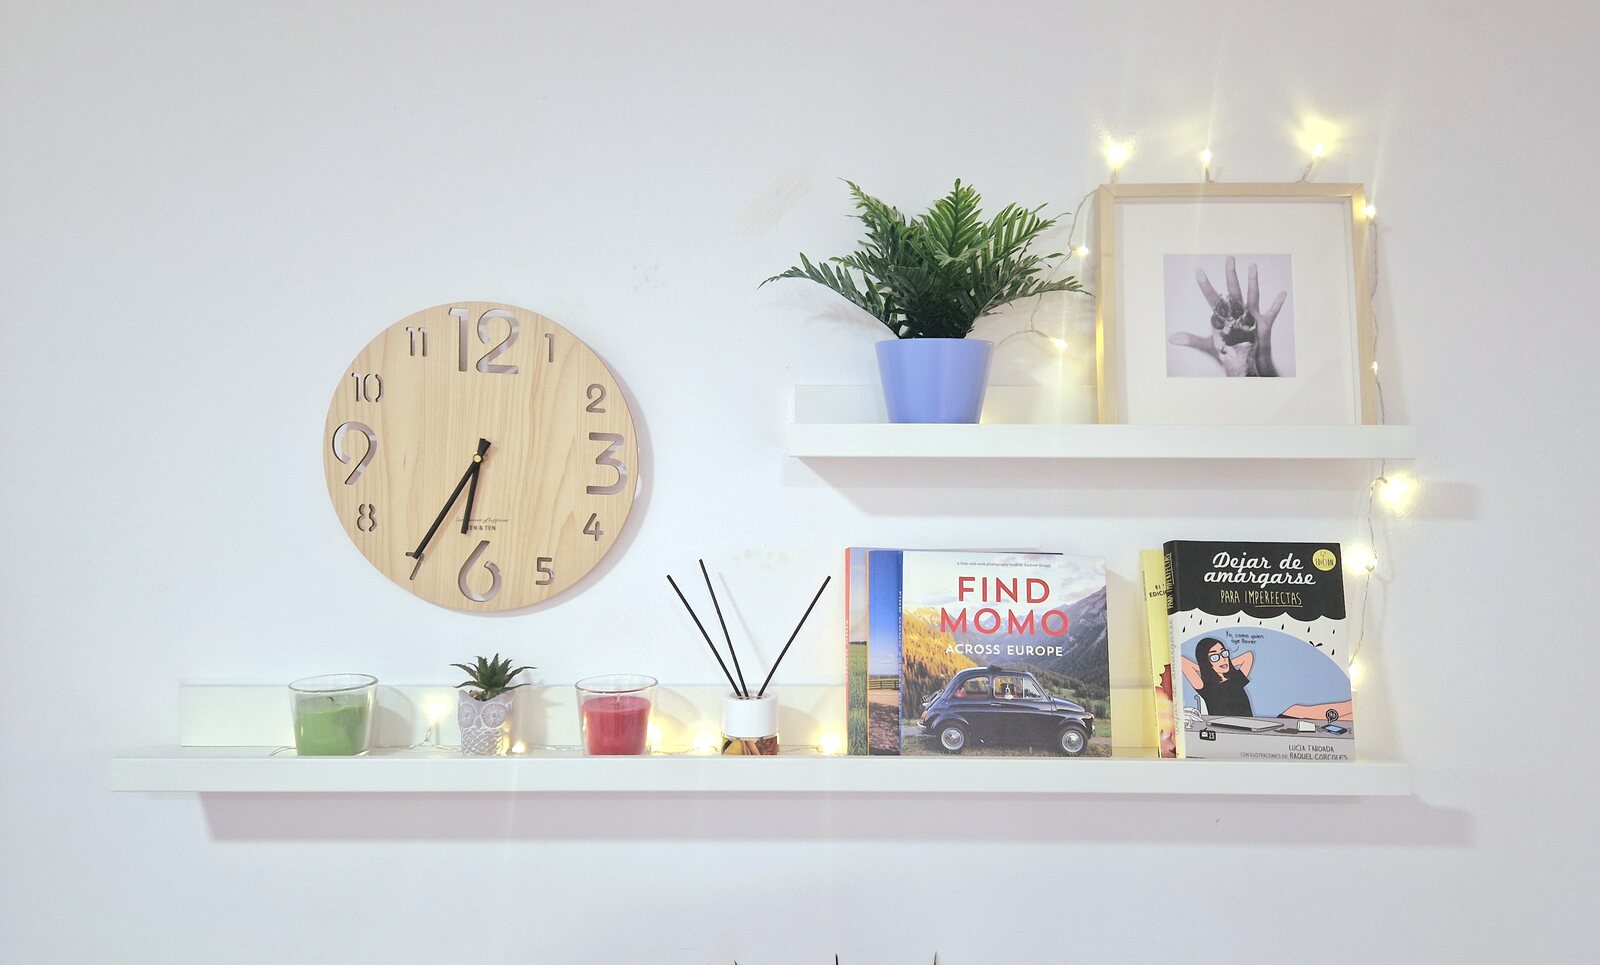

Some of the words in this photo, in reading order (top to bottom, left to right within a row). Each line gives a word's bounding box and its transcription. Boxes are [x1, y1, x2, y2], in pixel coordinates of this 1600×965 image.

[406, 327, 429, 357] 11
[449, 307, 519, 374] 12
[544, 333, 554, 363] 1
[351, 372, 384, 402] 10
[586, 383, 606, 413] 2
[332, 421, 377, 485] 9
[586, 432, 628, 495] 3
[357, 503, 377, 532] 8
[583, 513, 604, 541] 4
[405, 551, 425, 580] 7
[458, 540, 502, 602] 6
[535, 557, 555, 585] 5
[1212, 551, 1272, 573] Dejar
[1279, 552, 1304, 570] de
[958, 576, 1050, 604] FIND
[1149, 590, 1166, 598] EDICI
[1203, 571, 1317, 589] amargarse
[1220, 589, 1240, 604] PARA
[1244, 590, 1302, 606] IMPERFECTAS
[940, 607, 1070, 637] MOMO
[945, 644, 1001, 655] ACROSS
[1007, 645, 1063, 657] EUROPE
[1289, 752, 1313, 760] RAQUEL
